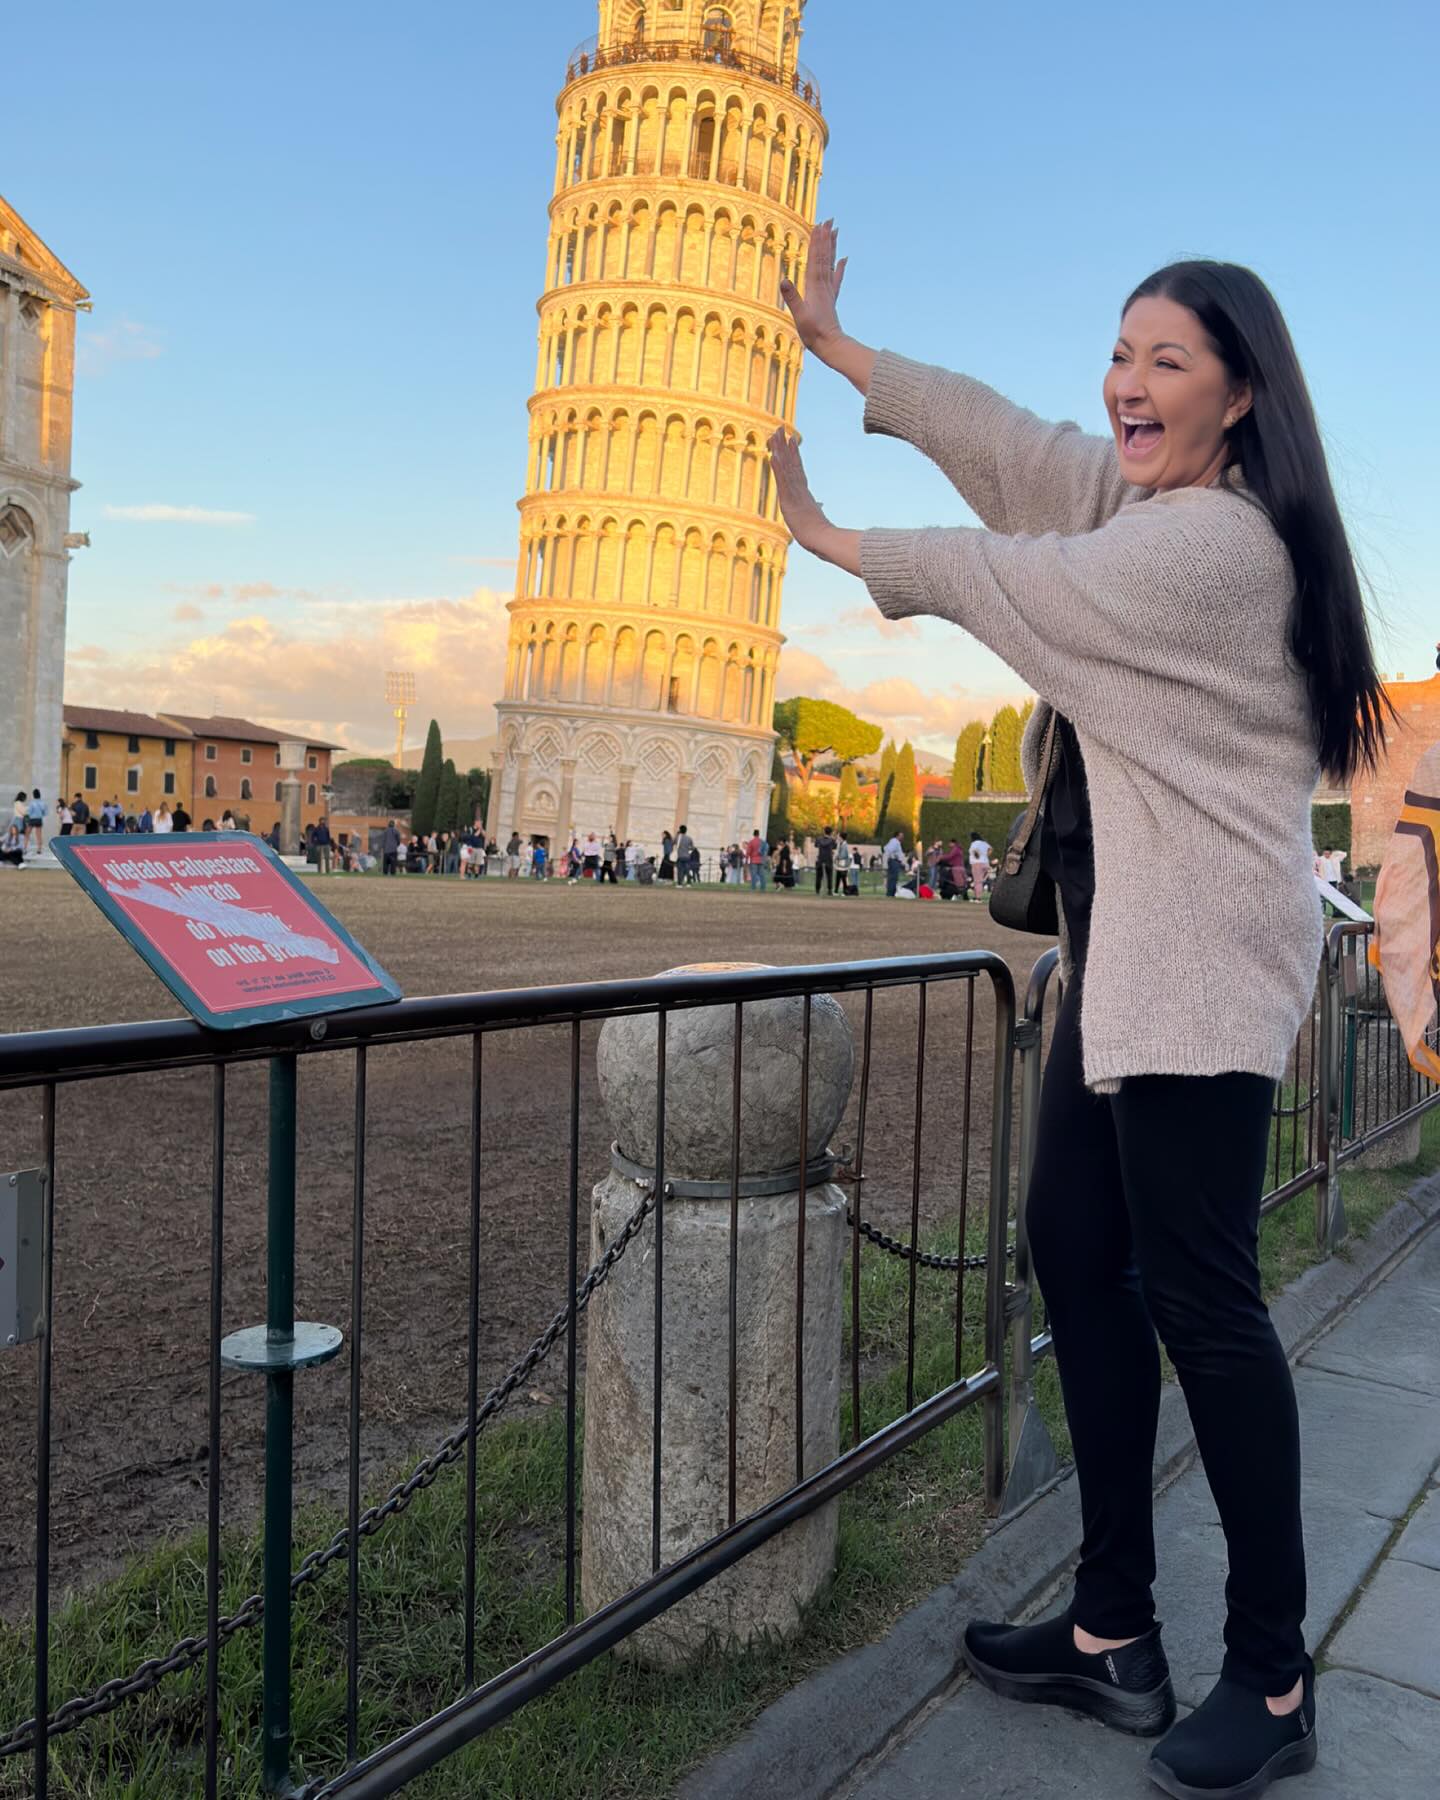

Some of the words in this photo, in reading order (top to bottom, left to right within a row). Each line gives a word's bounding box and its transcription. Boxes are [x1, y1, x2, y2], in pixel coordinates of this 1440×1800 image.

[103, 859, 173, 880] vietato
[168, 856, 261, 878] calpestare
[185, 919, 217, 941] do
[206, 948, 238, 967] on
[229, 942, 268, 964] the
[262, 940, 313, 963] gra
